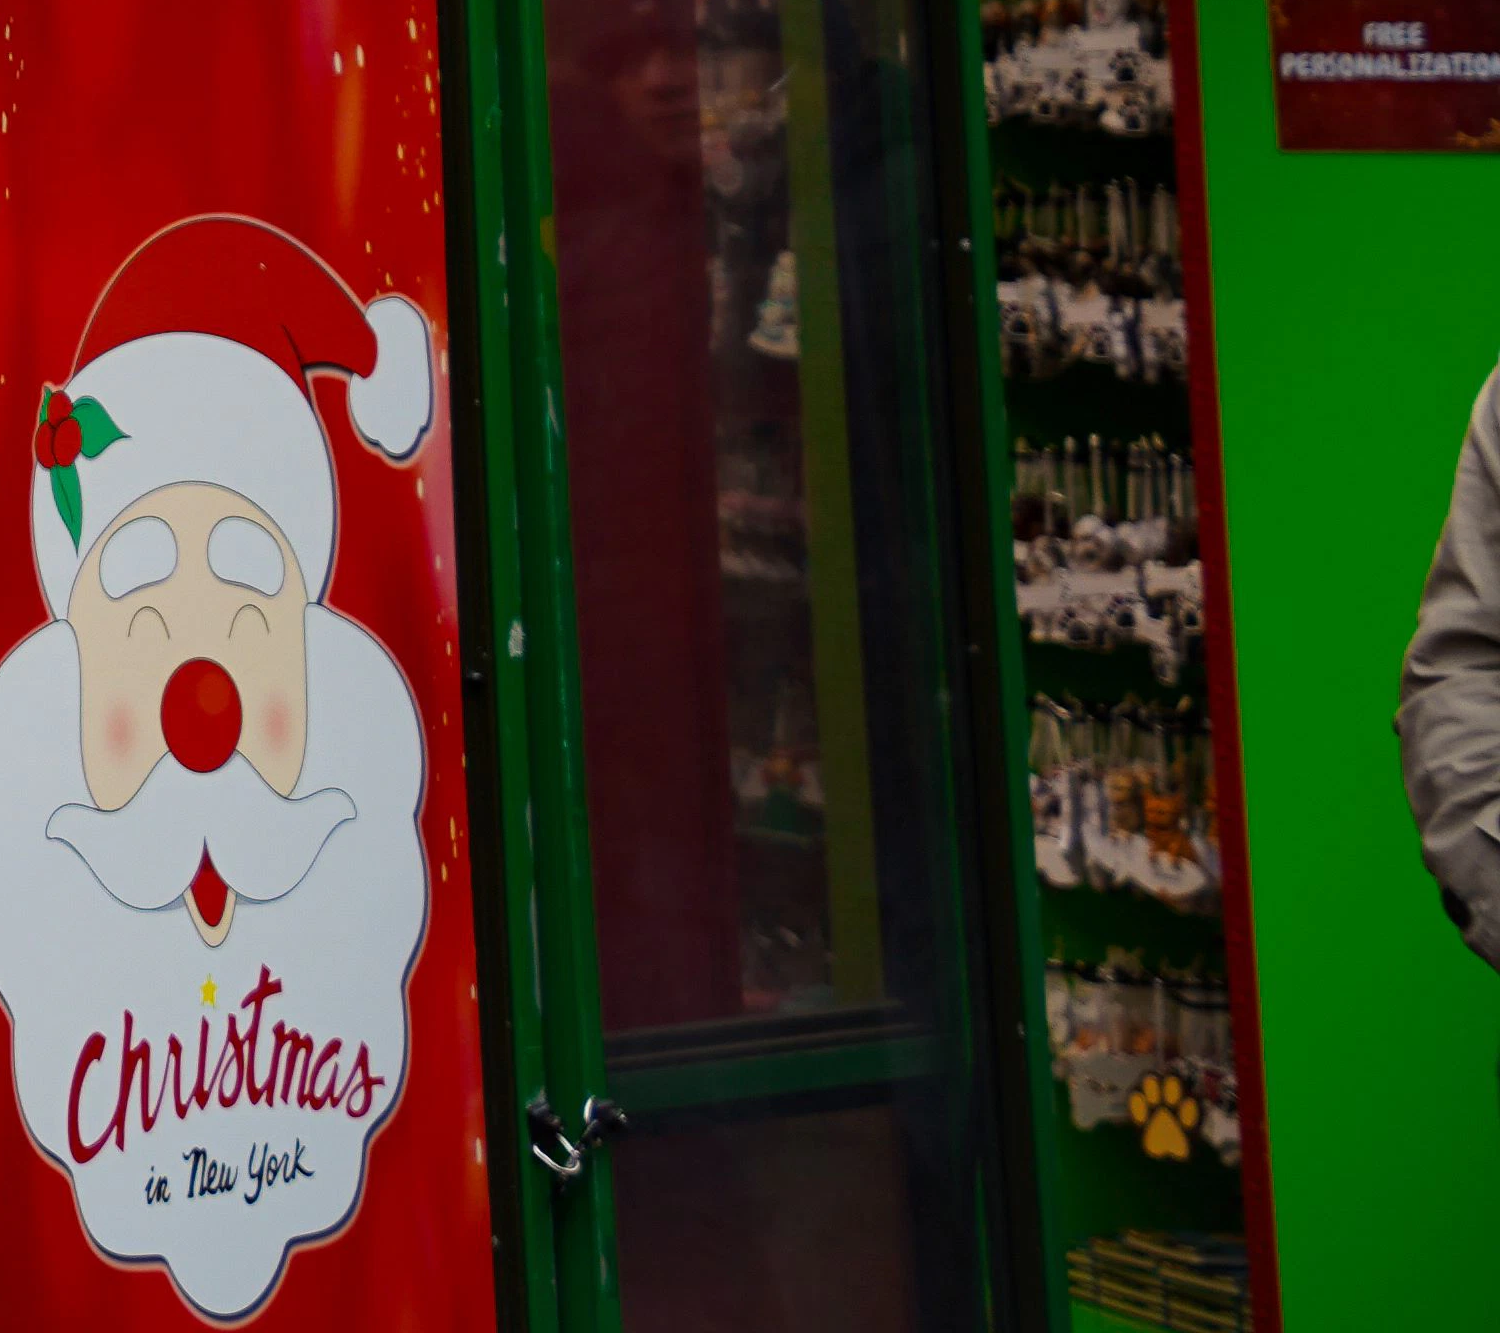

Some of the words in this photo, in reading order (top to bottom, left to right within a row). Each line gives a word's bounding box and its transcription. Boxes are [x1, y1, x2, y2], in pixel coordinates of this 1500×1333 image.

[66, 963, 386, 1164] Christmas
[145, 1165, 171, 1205] in
[183, 1146, 238, 1200] New
[243, 1138, 315, 1205] York
